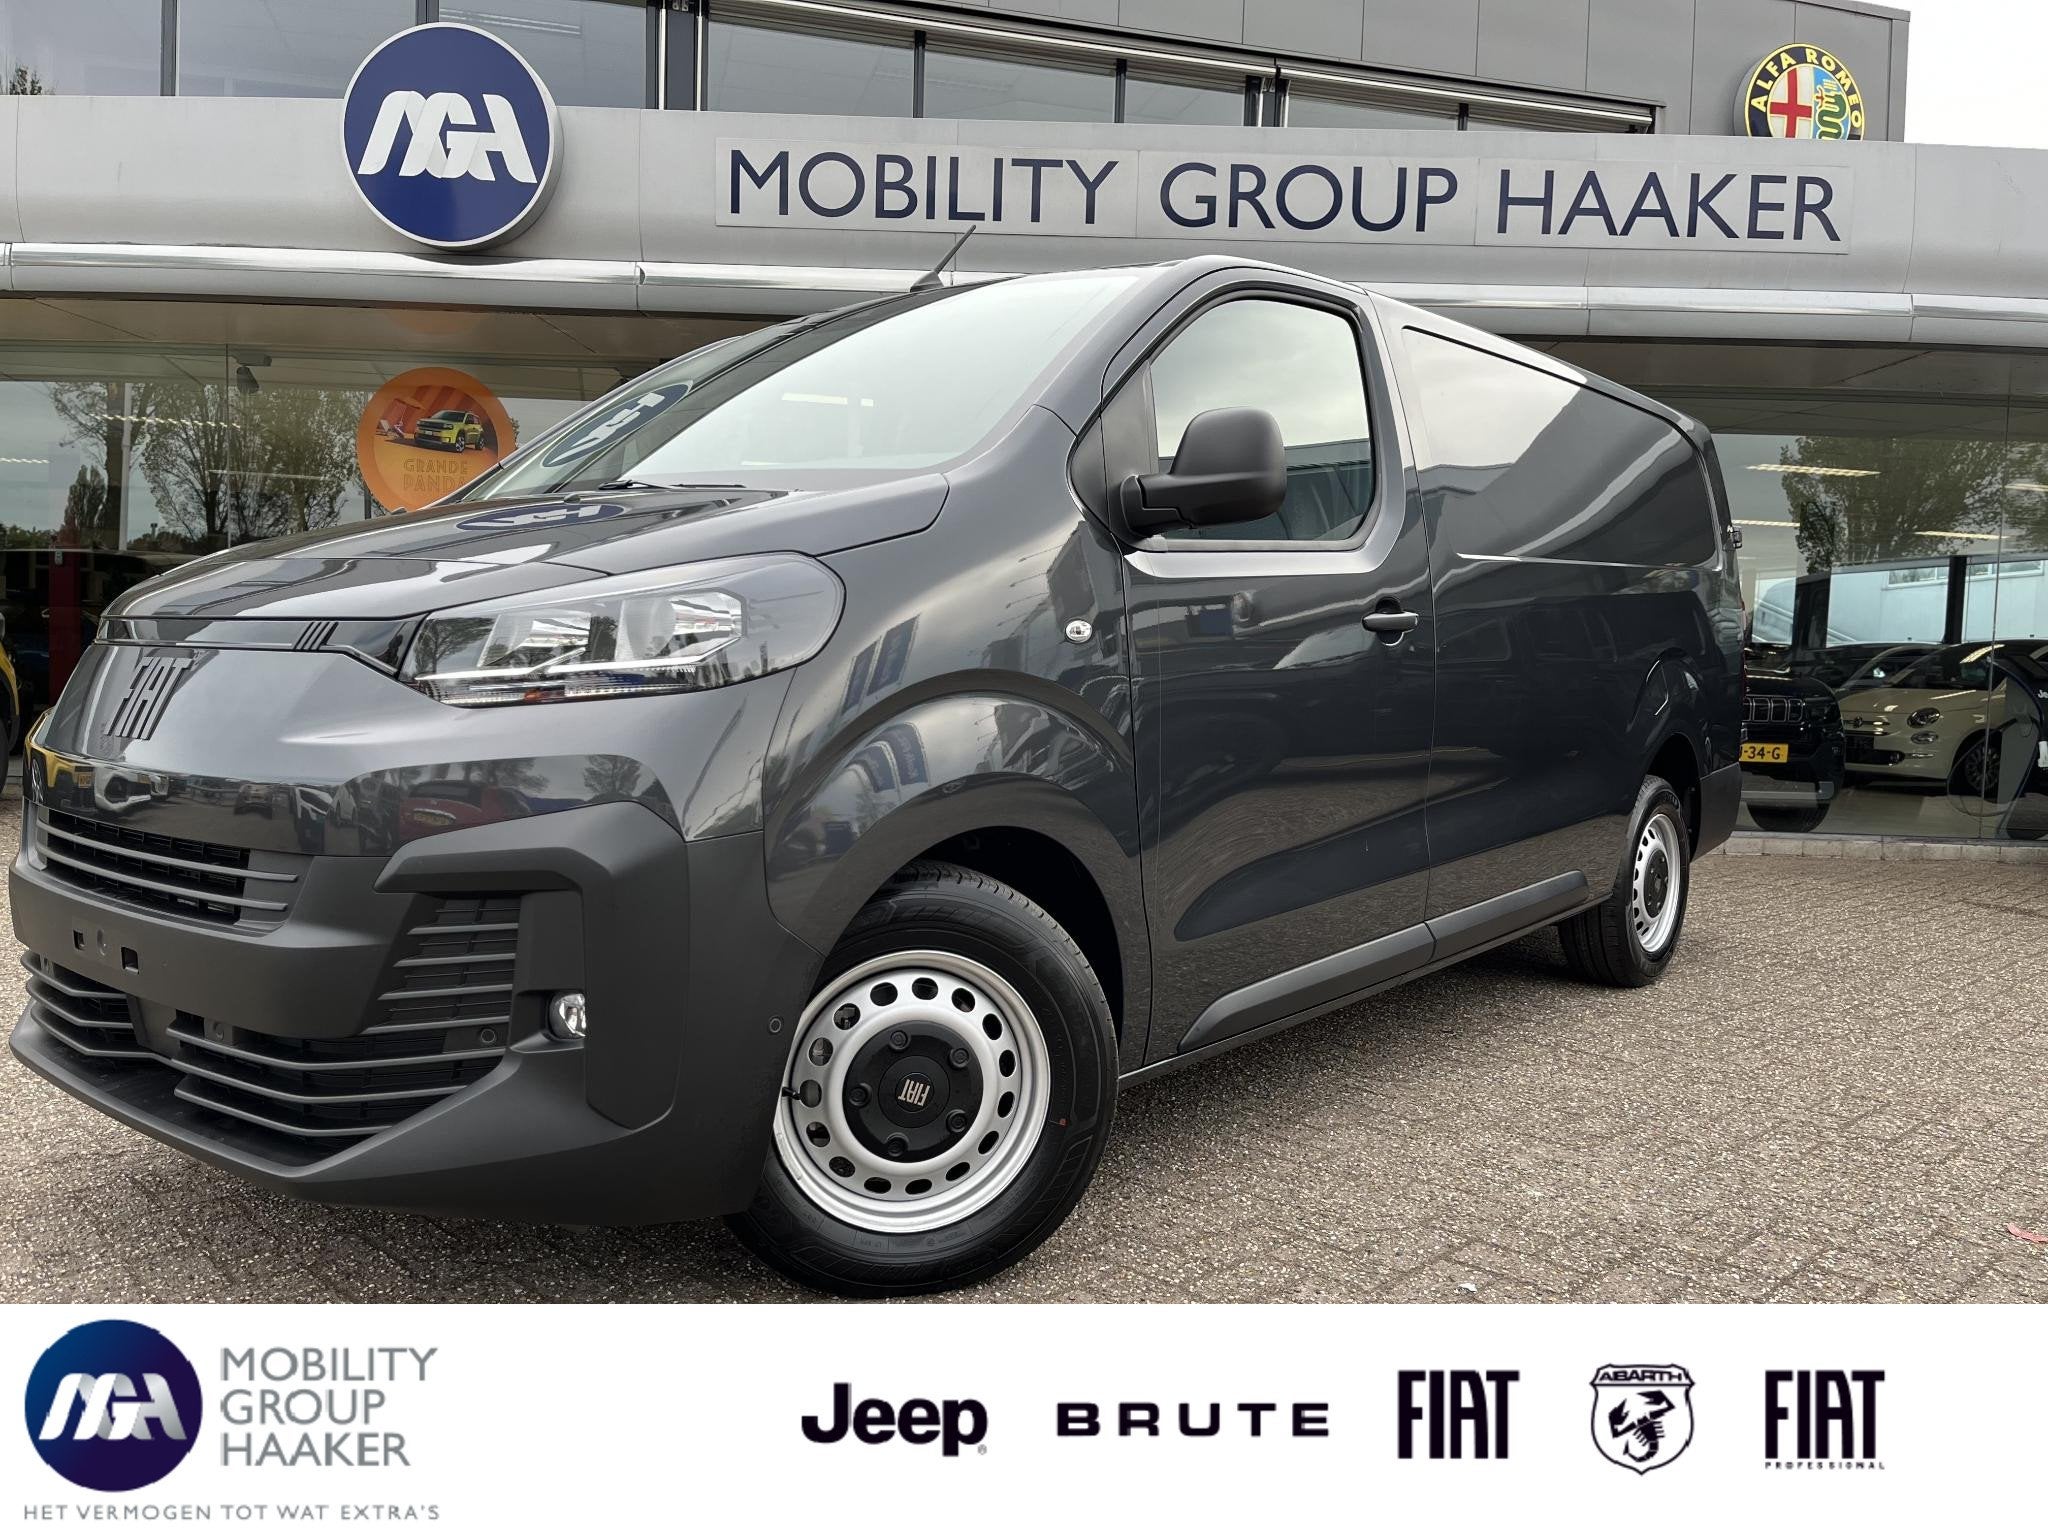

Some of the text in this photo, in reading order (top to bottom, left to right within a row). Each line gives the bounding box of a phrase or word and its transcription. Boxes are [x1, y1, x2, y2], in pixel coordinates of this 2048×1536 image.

[1750, 48, 1862, 128] ALFA ROMEO
[730, 149, 1841, 242] MOBILITY GROUP HAAKER
[403, 458, 468, 474] GRANDE
[104, 656, 194, 741] FIAT
[1740, 746, 1780, 760] -34-G
[897, 1079, 931, 1107] FIAT
